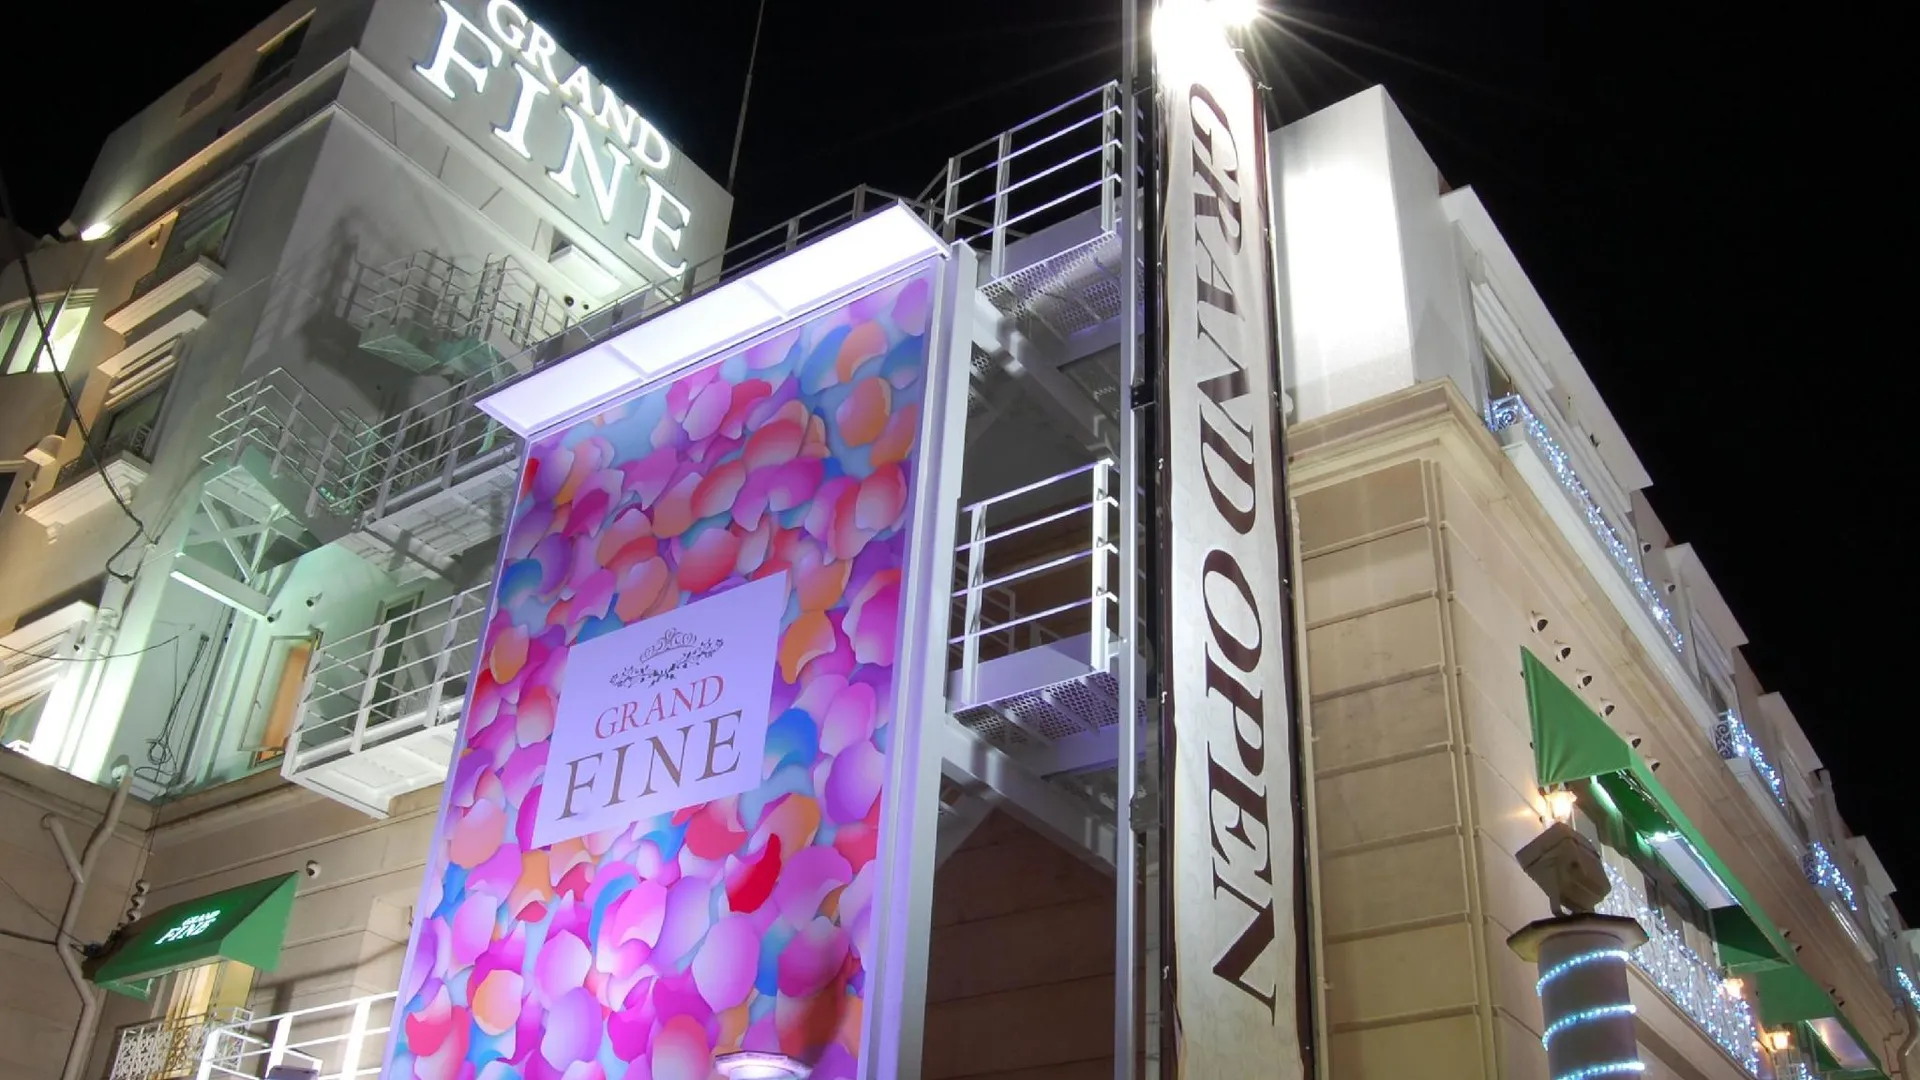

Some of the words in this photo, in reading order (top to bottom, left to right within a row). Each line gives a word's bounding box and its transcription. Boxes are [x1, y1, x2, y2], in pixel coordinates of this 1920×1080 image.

[414, 0, 691, 282] FINE
[487, 0, 670, 170] GRAND
[1189, 83, 1256, 535] GRAND
[555, 709, 742, 821] FINE
[594, 675, 725, 739] GRAND
[1202, 548, 1276, 1026] OPEN
[154, 917, 217, 945] FINE
